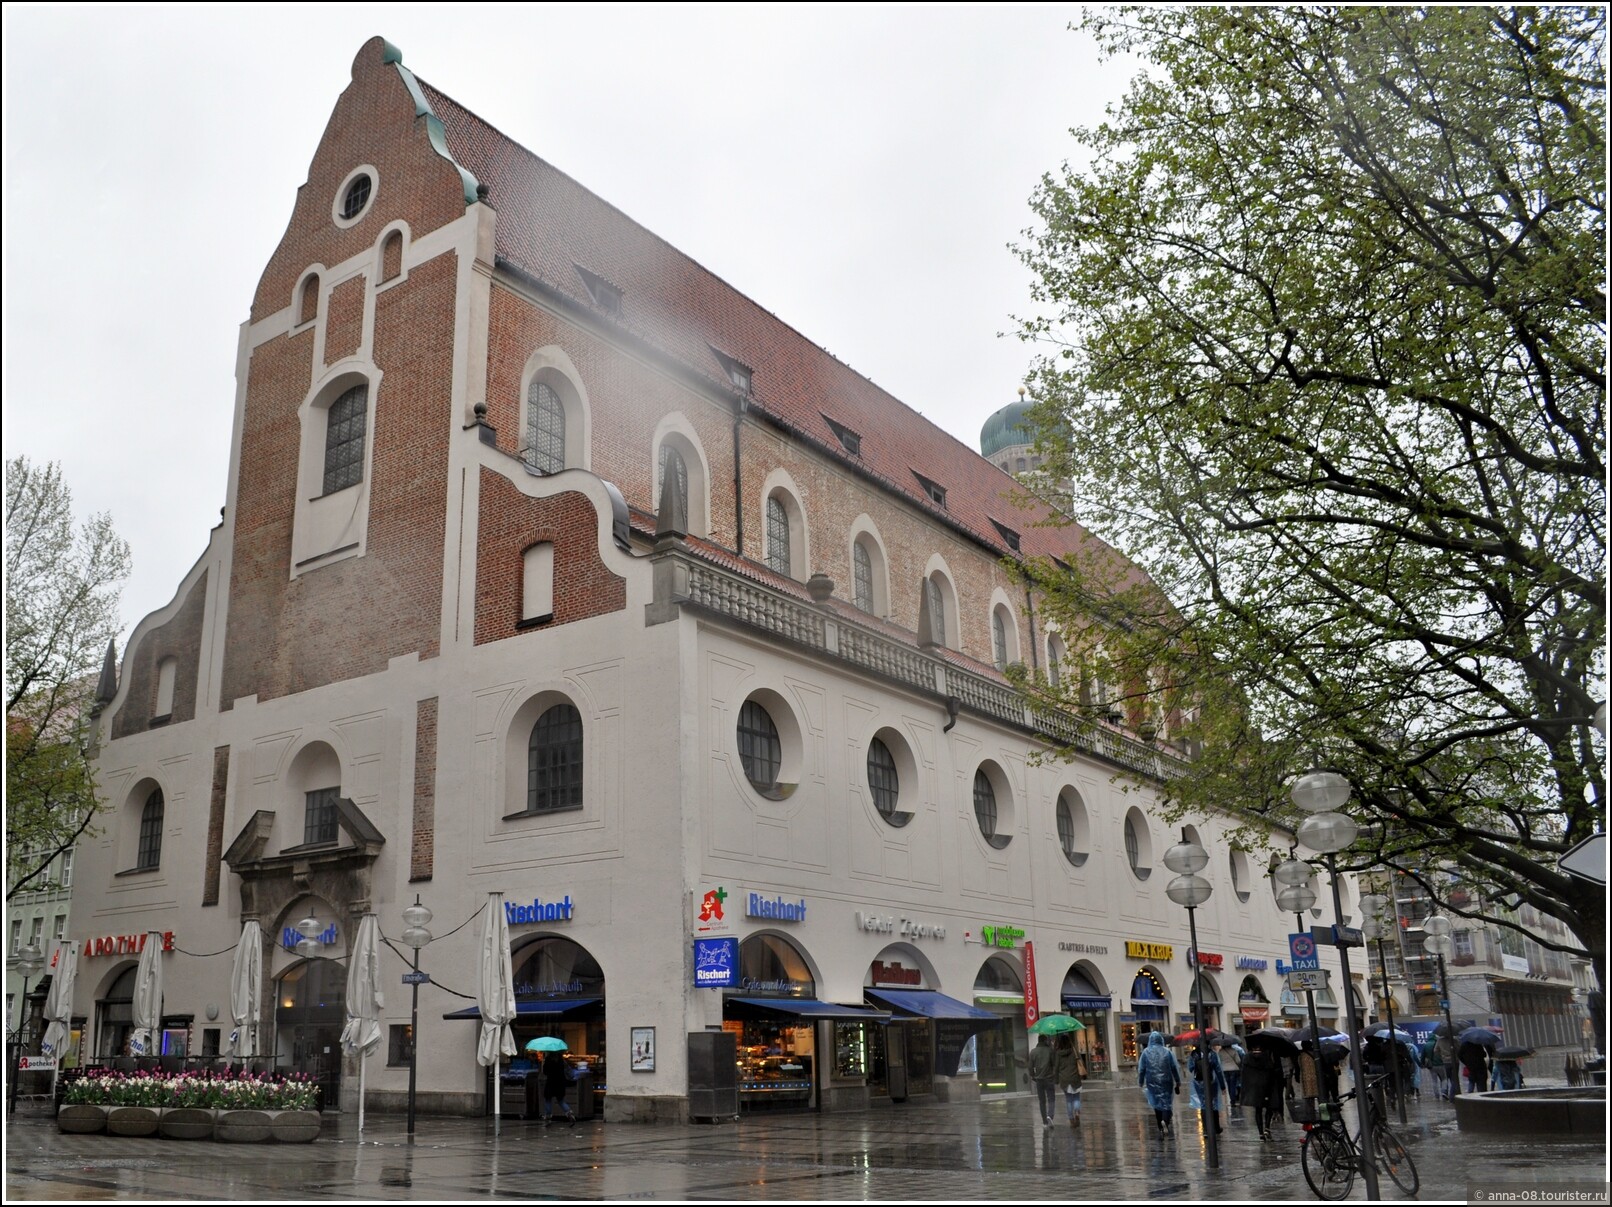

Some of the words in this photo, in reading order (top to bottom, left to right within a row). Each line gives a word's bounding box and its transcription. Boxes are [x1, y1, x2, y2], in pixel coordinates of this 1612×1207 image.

[749, 893, 807, 921] Rischart
[84, 931, 174, 956] APOTHEE
[1127, 941, 1149, 958] MAX
[1150, 944, 1173, 960] KRUG
[1294, 960, 1317, 969] TAXI
[697, 969, 731, 980] Rischart
